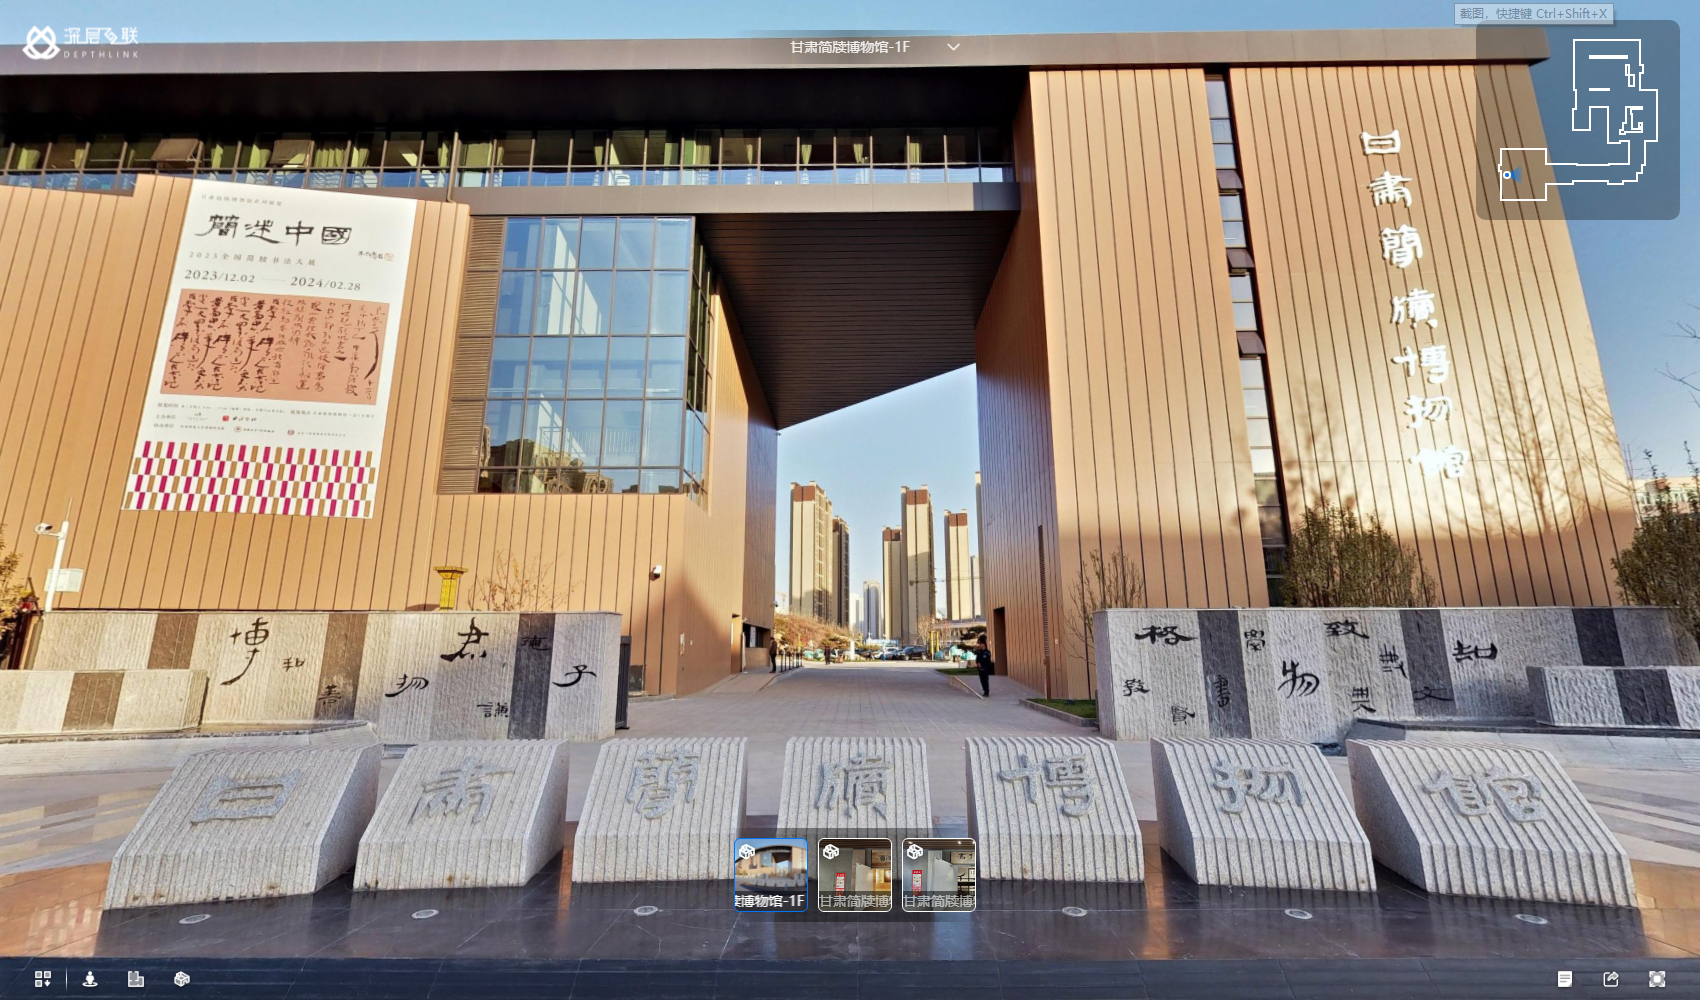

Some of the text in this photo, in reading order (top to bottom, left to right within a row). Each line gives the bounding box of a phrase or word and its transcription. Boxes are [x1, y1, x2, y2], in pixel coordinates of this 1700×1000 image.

[184, 268, 362, 292] 2023/12.02 2024/02.28
[1134, 625, 1199, 646] 格
[1323, 619, 1370, 640] 致
[552, 664, 597, 688] 子
